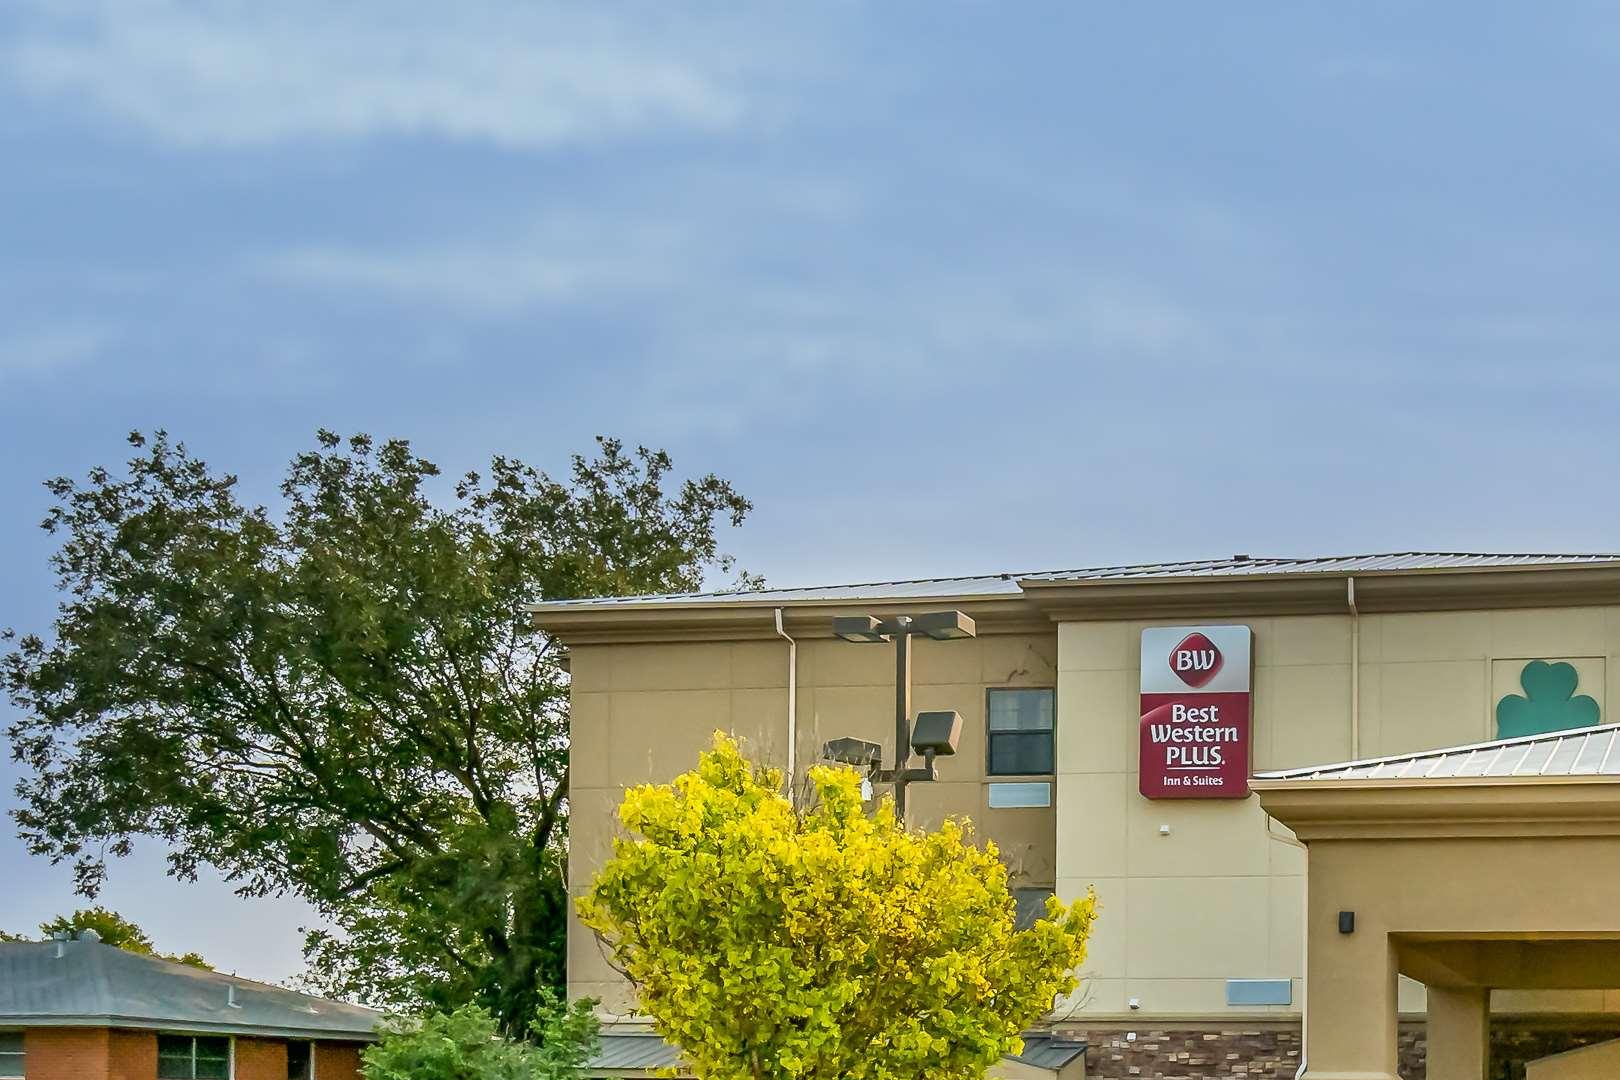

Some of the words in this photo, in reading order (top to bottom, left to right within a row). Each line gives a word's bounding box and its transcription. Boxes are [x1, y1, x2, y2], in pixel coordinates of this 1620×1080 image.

[1176, 650, 1215, 671] BW
[1172, 704, 1219, 723] Best
[1150, 724, 1238, 743] Western
[1163, 776, 1181, 786] Inn
[1182, 776, 1191, 786] &
[1192, 775, 1224, 786] Suites
